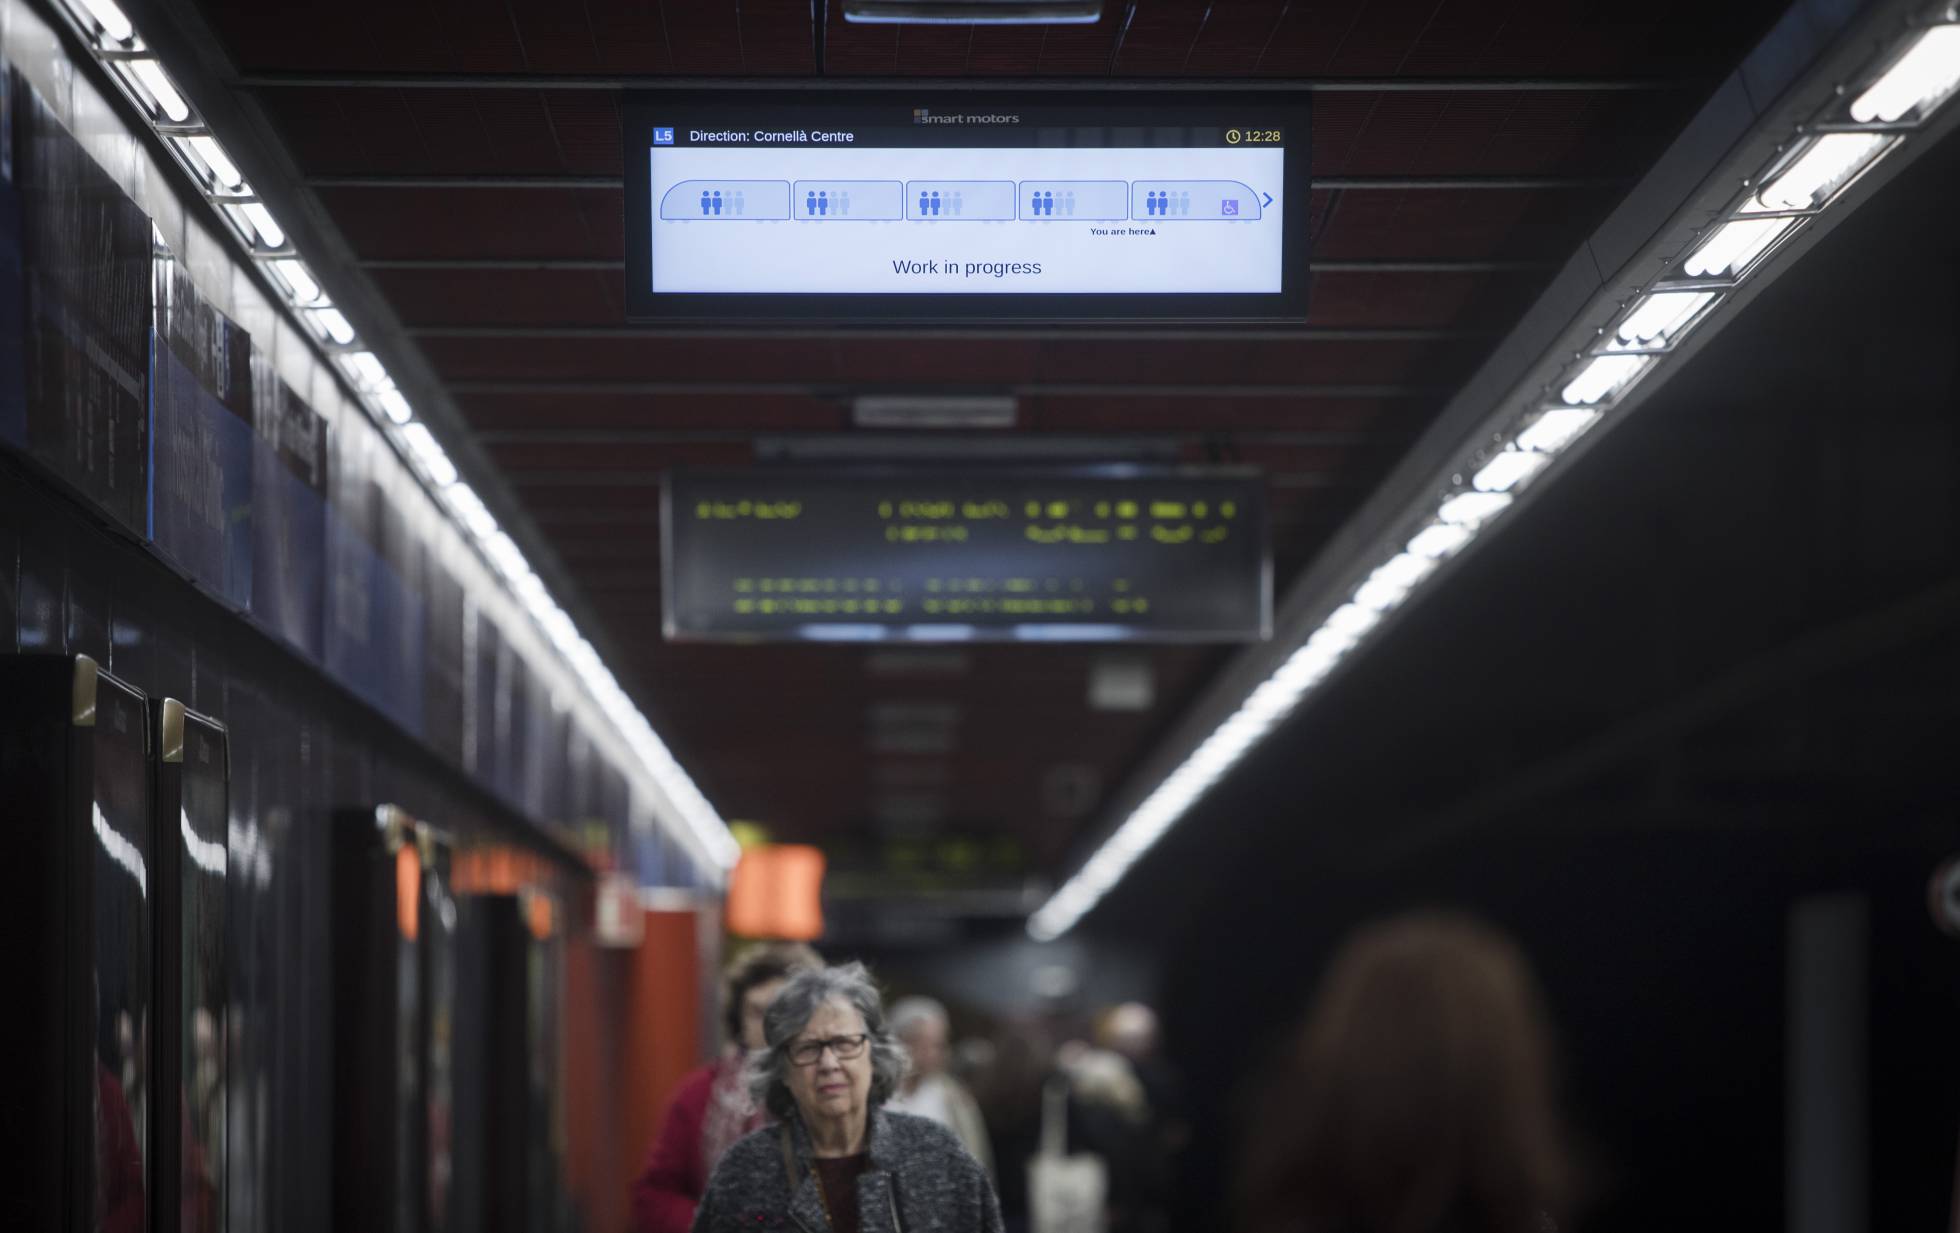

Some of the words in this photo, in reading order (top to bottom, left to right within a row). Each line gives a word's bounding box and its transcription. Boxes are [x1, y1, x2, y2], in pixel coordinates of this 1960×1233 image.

[921, 114, 964, 124] smart
[966, 114, 1019, 124] motors
[655, 130, 673, 142] L5
[689, 130, 750, 142] Direction:
[753, 130, 808, 142] Cornellà
[811, 130, 854, 142] Centre
[1245, 130, 1281, 142] 12:28
[1090, 227, 1109, 236] You
[1110, 228, 1126, 236] are
[1128, 227, 1150, 236] here
[892, 259, 938, 275] Work
[944, 259, 959, 274] in
[965, 262, 1042, 278] progress
